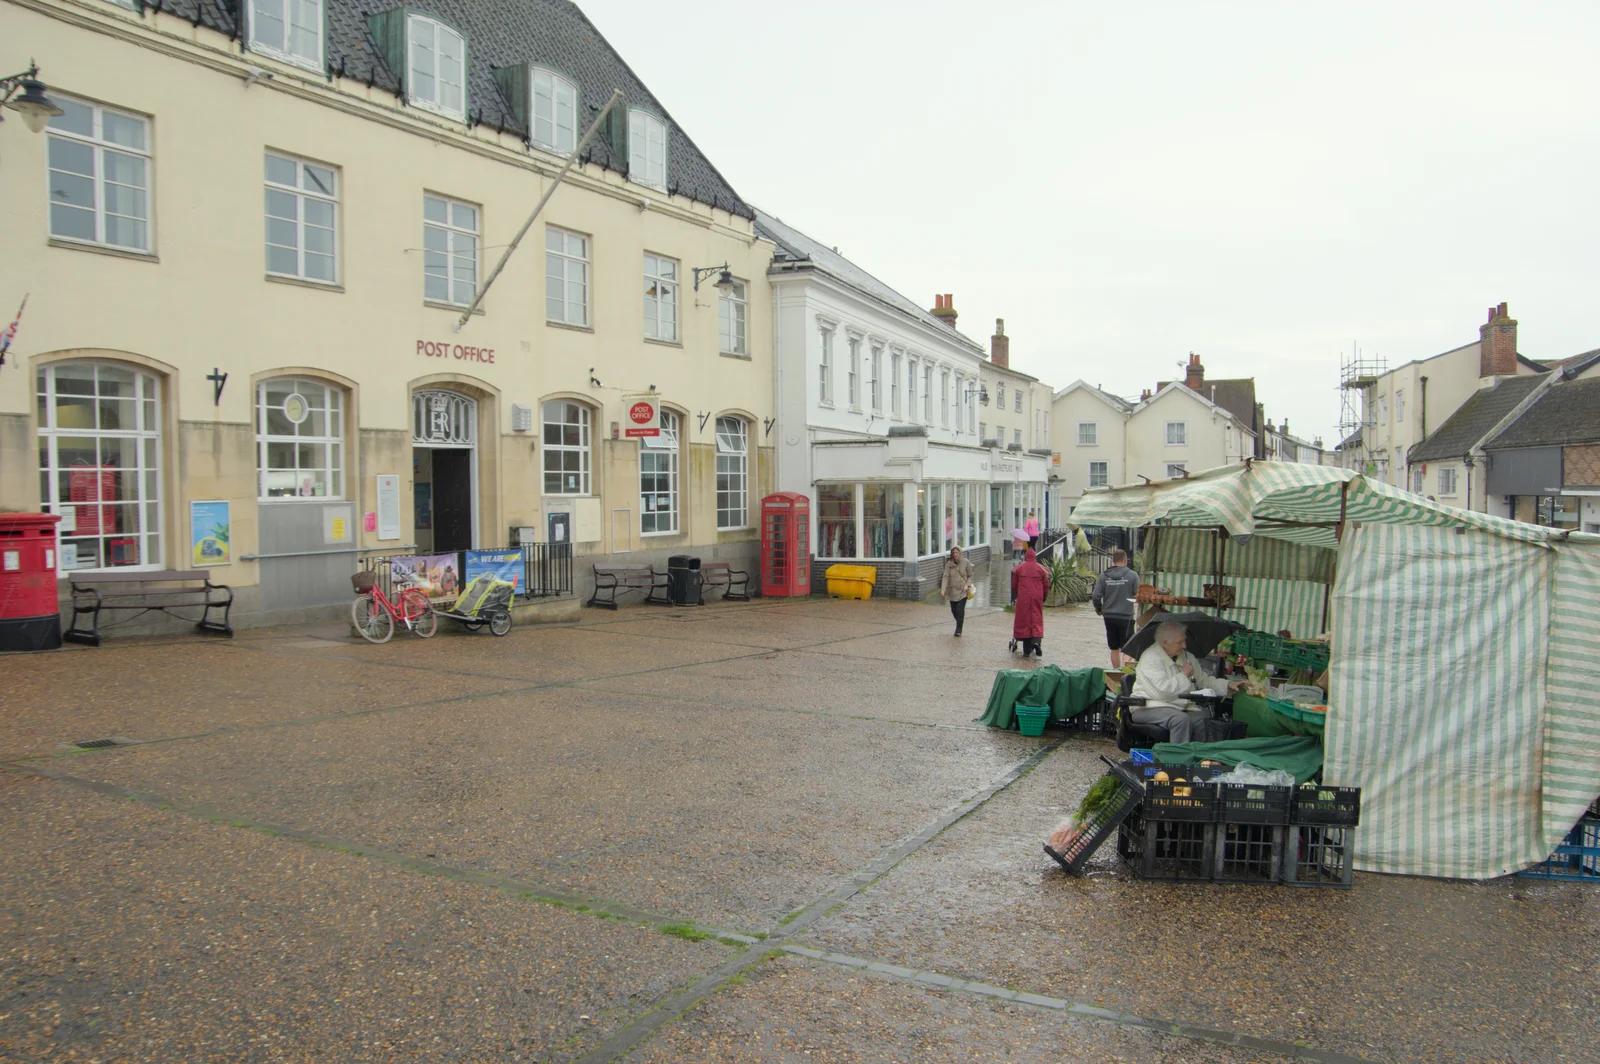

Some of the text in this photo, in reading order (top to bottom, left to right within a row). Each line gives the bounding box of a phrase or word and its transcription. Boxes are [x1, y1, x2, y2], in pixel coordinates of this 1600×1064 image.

[416, 340, 495, 364] POST OFFICE
[431, 411, 450, 432] ER
[481, 555, 492, 563] WE
[492, 555, 504, 563] ARE
